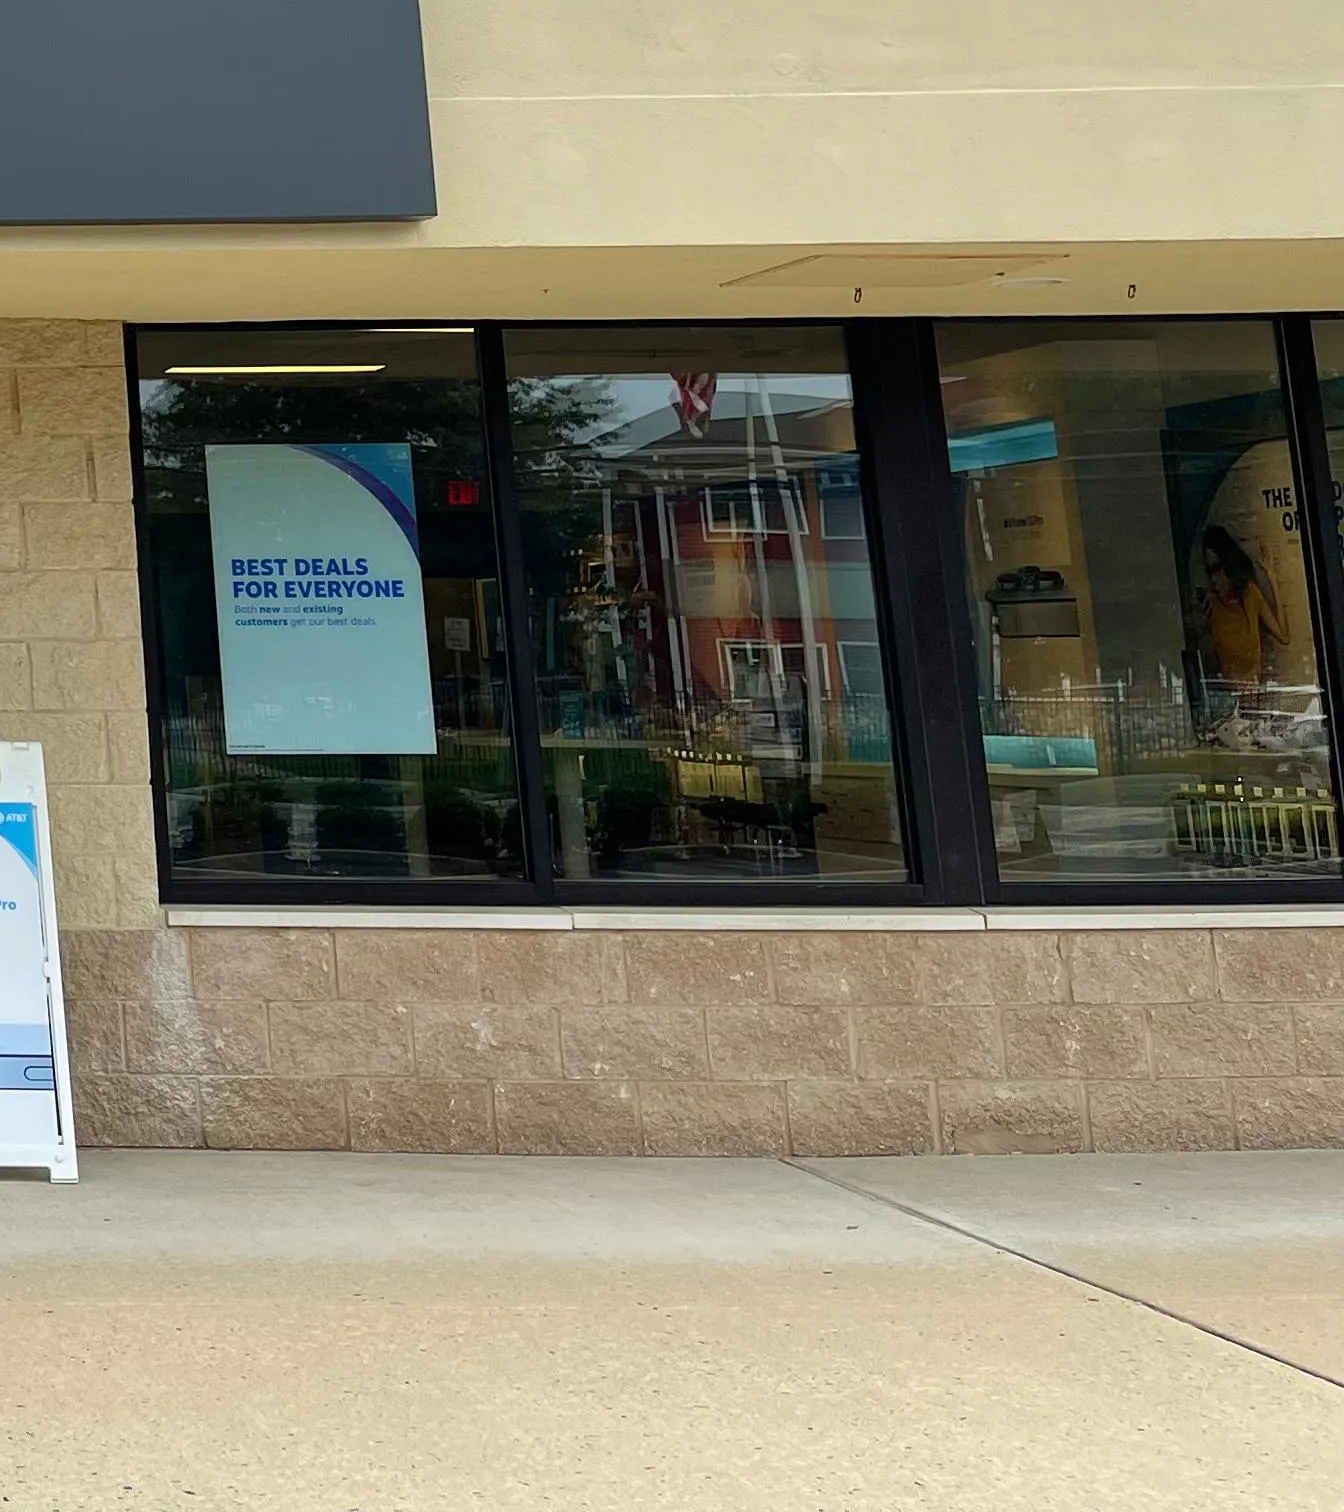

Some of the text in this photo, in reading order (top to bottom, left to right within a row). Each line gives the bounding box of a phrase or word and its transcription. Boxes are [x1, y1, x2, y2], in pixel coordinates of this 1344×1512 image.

[1262, 487, 1292, 509] THE
[231, 558, 368, 576] BEST DEALS
[233, 580, 404, 598] FOR EVERYONE
[234, 604, 343, 615] Both new and existing
[235, 618, 288, 626] customers
[290, 618, 306, 628] get
[327, 617, 347, 626] best
[5, 813, 27, 823] AT&T
